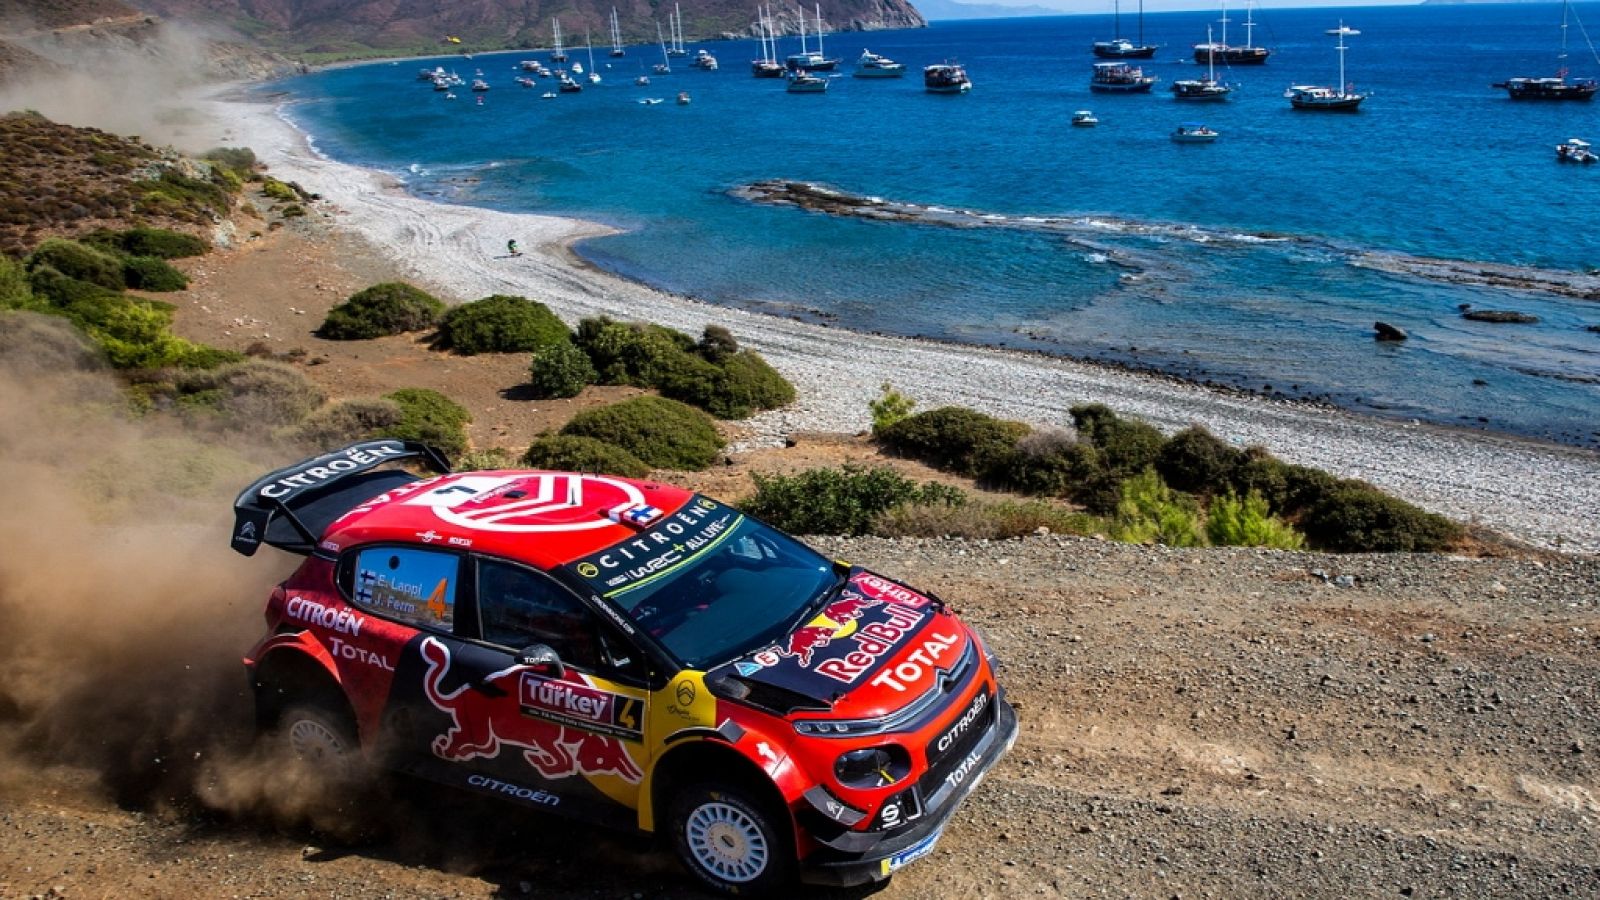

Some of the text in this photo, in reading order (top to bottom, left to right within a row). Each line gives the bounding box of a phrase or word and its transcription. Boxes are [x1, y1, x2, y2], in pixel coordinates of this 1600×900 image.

[260, 446, 401, 499] CITROËN
[600, 503, 709, 568] CITROËN
[387, 595, 416, 613] Ferm
[391, 576, 423, 597] Lappi
[427, 576, 449, 619] 4
[287, 596, 365, 637] CITROËN
[328, 636, 395, 671] TOTAL
[871, 632, 959, 692] TOTAL
[619, 700, 635, 729] 4
[938, 693, 987, 751] CITROËN
[945, 751, 982, 787] TOTAL
[468, 775, 561, 806] CITROËN
